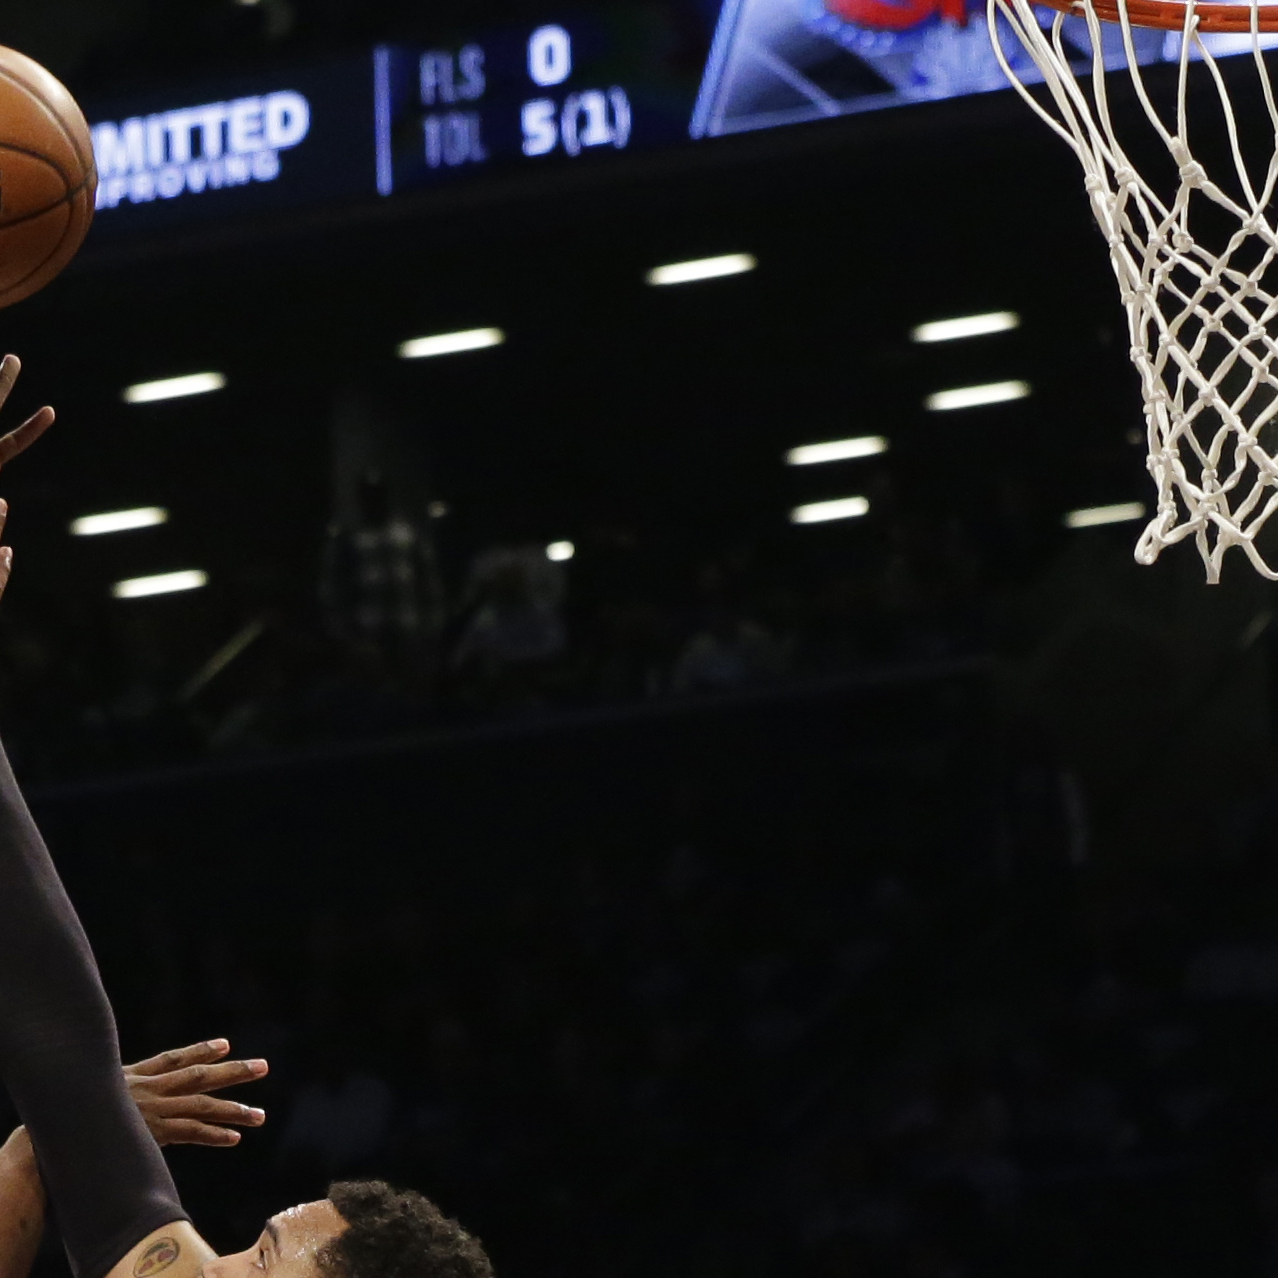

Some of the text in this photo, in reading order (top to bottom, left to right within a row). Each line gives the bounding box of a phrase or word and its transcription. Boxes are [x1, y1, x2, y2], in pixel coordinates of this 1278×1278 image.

[419, 24, 571, 106] FLS 0
[92, 90, 310, 178] MITTED
[521, 85, 631, 157] 5(1)
